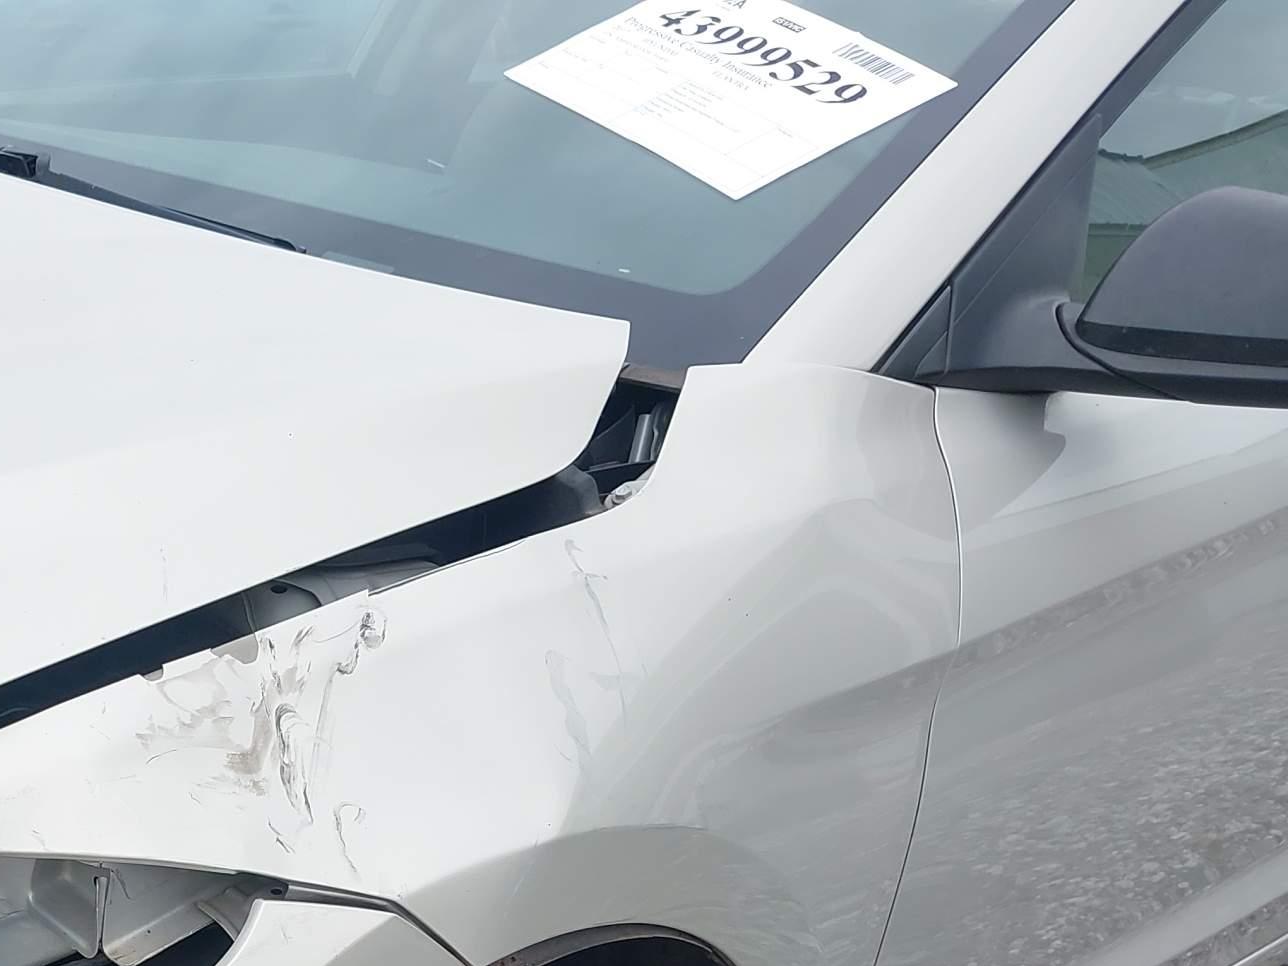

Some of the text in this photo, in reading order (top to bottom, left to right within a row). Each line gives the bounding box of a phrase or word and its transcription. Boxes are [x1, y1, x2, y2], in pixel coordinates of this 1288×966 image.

[660, 9, 869, 105] 43999529
[680, 41, 721, 65] Casualty
[722, 61, 773, 89] Insurance
